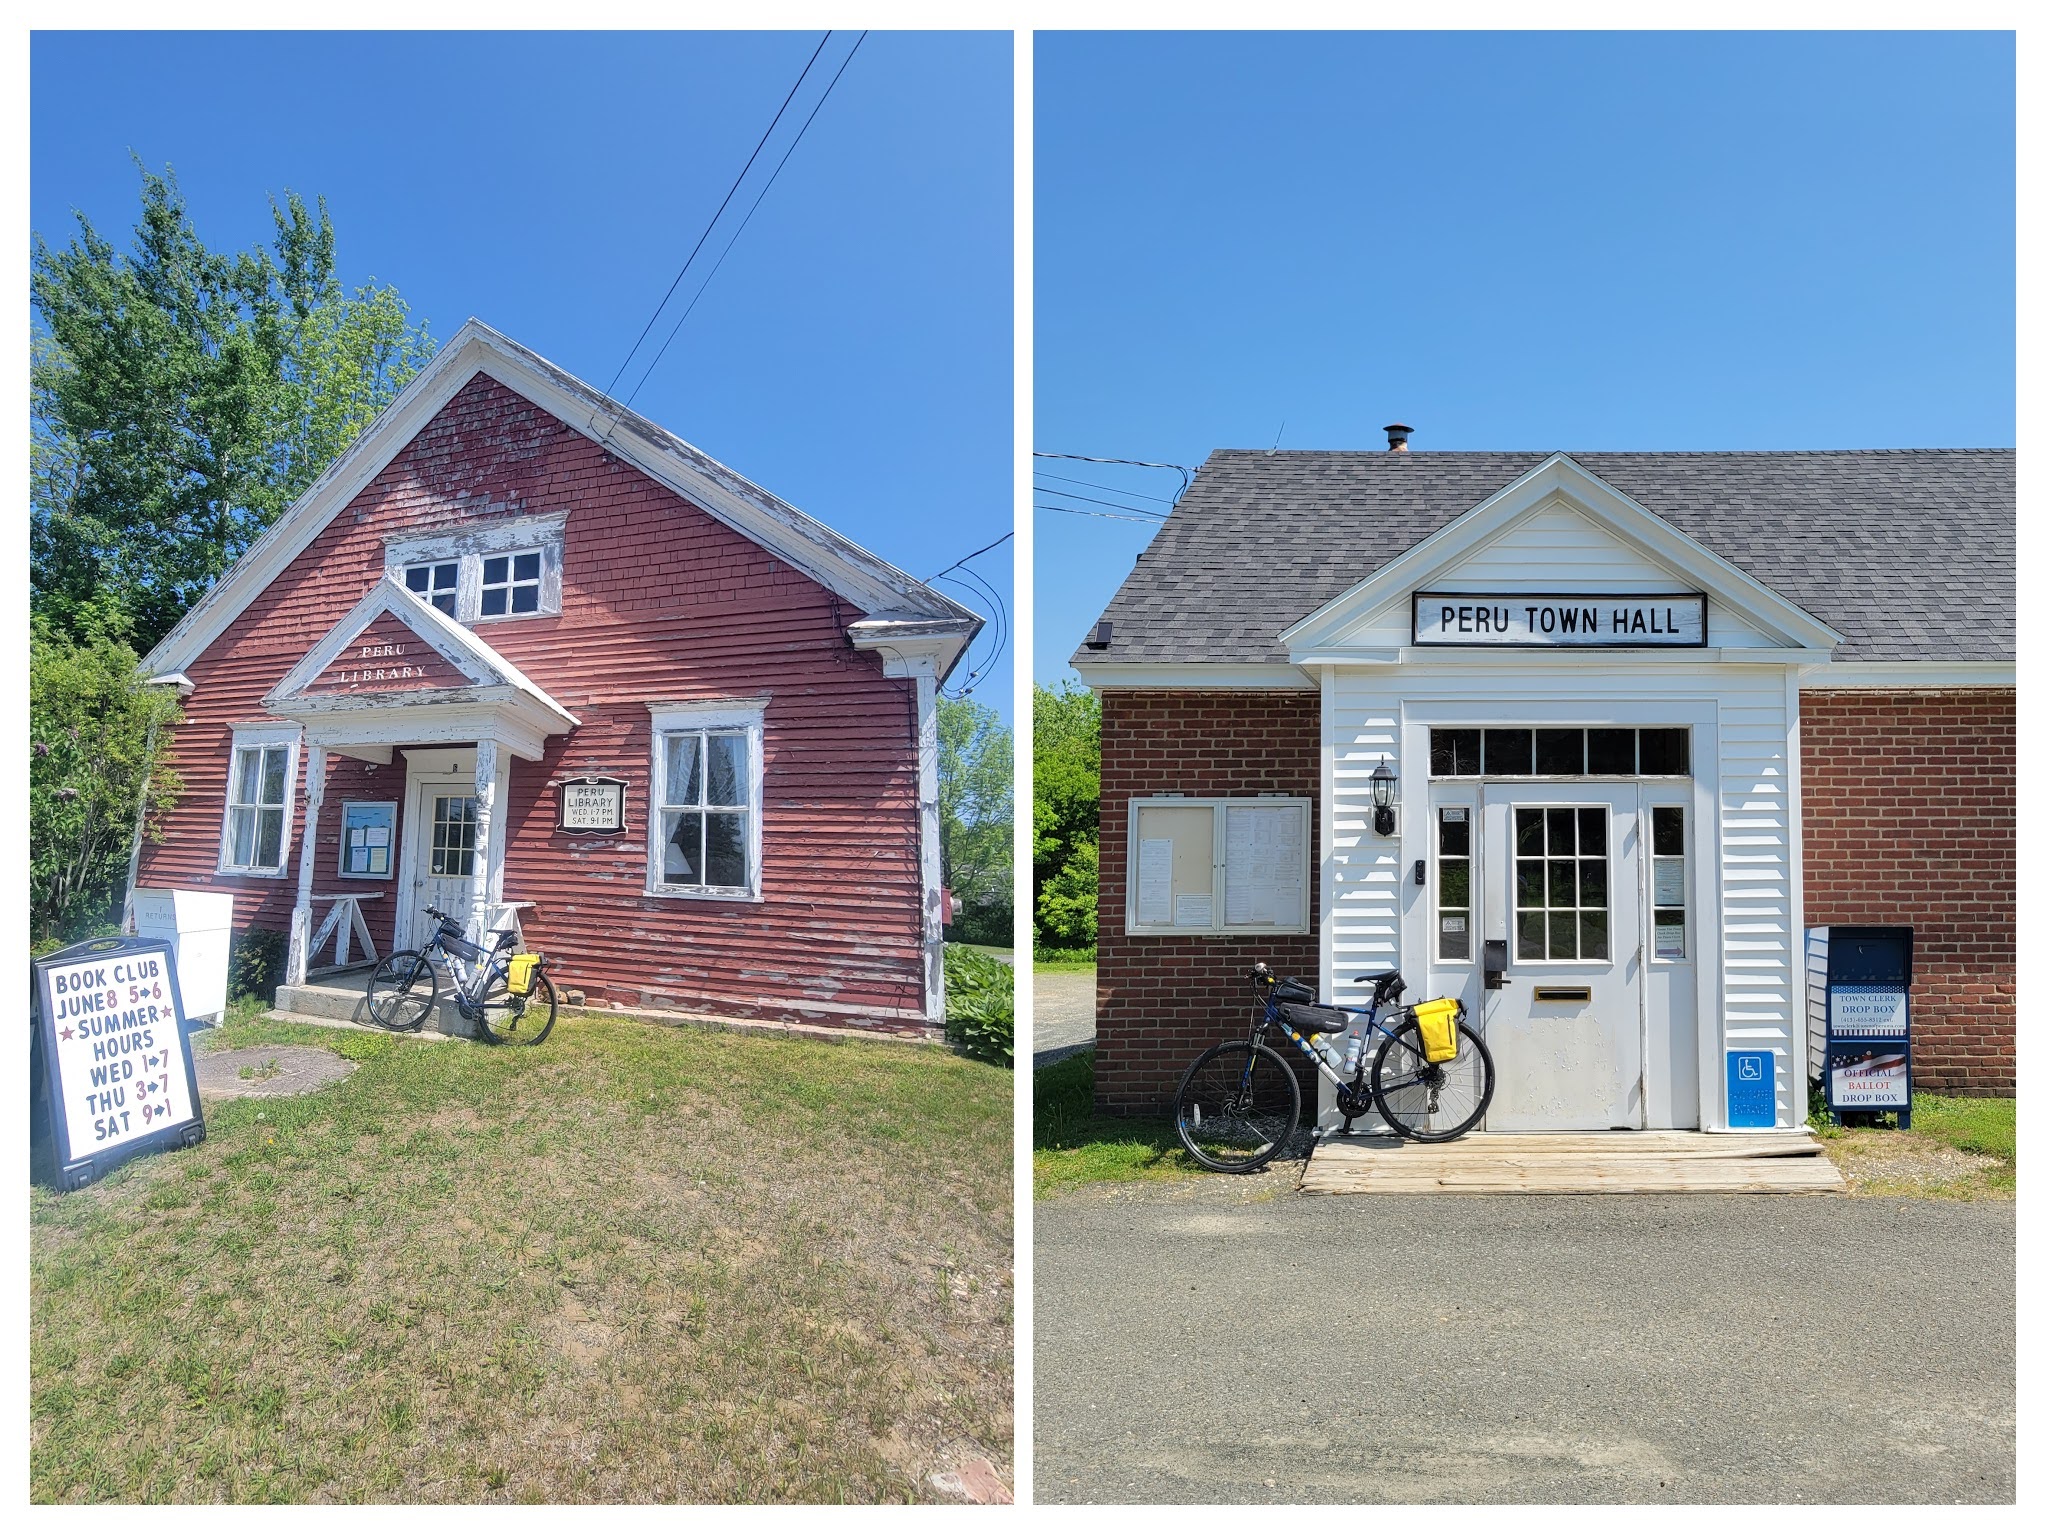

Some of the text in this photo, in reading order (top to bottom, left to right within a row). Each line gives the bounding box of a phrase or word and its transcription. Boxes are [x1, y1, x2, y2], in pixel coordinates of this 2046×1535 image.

[1441, 606, 1680, 634] PERU TOWN HALL
[361, 644, 406, 658] PERU
[340, 665, 426, 683] LIBRARY
[576, 787, 605, 797] PERU
[567, 797, 614, 808] LIBRARY
[55, 960, 160, 994] BOOK CLUB
[1842, 1005, 1895, 1014] DROP BOX
[78, 1005, 160, 1040] SUMMER
[93, 1029, 155, 1062] HOURS
[89, 1059, 133, 1088] WED
[1844, 1069, 1895, 1077] OFFICIAL
[1848, 1081, 1891, 1090] BALLOT
[85, 1086, 126, 1116] THU
[1842, 1093, 1898, 1102] DROP BOX
[94, 1110, 131, 1141] SAT
